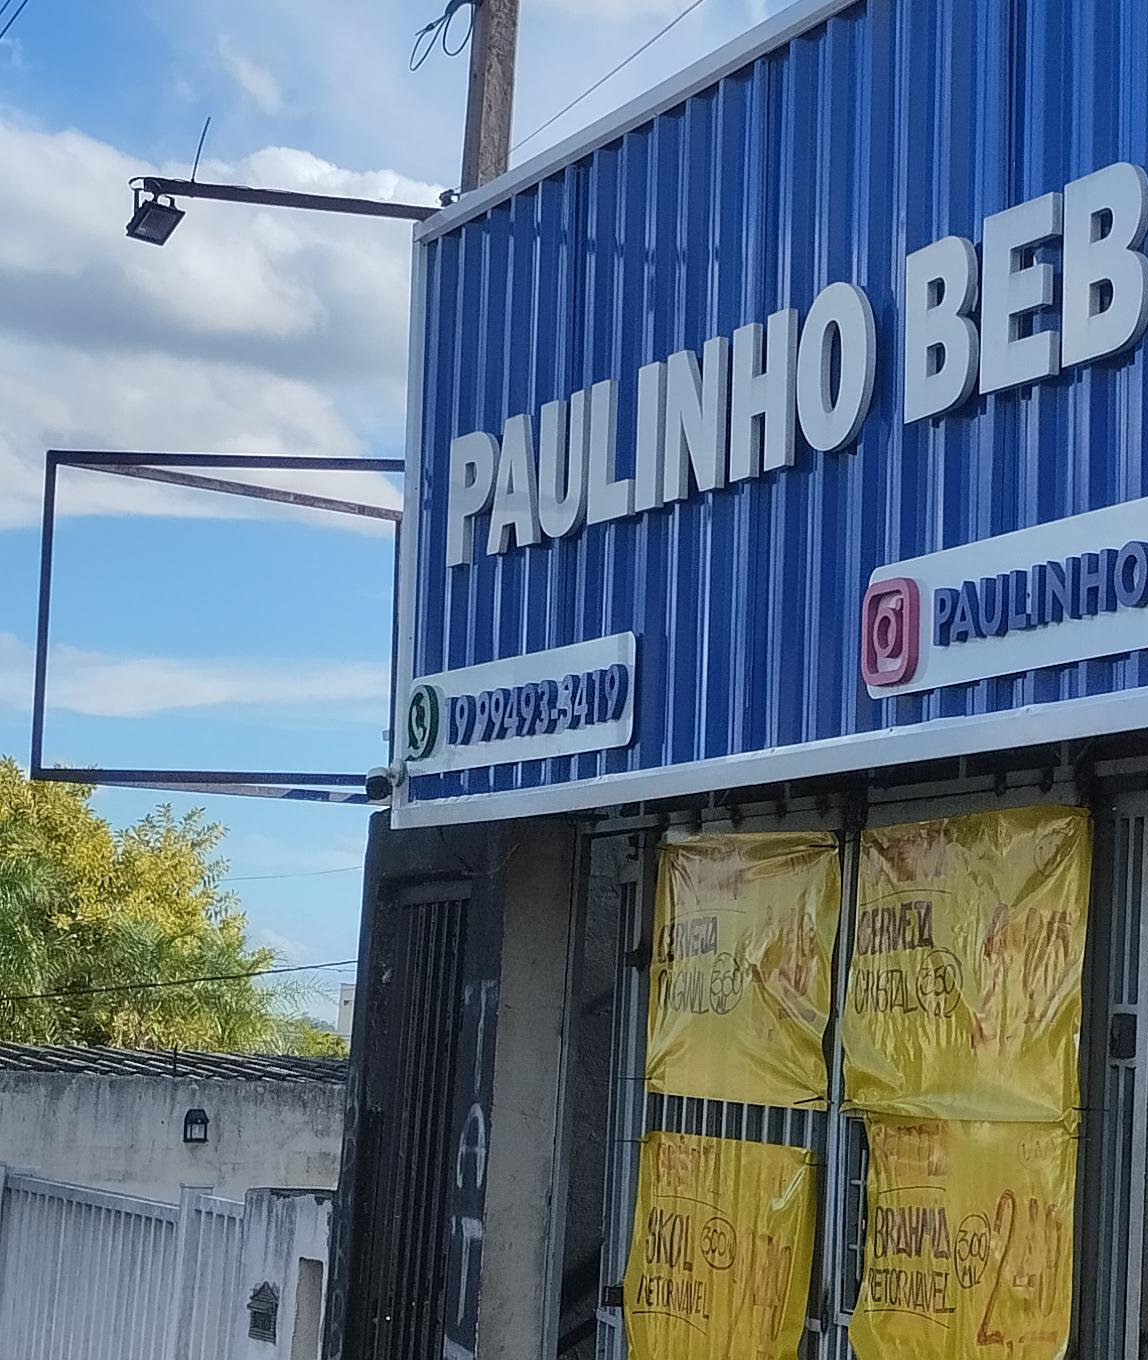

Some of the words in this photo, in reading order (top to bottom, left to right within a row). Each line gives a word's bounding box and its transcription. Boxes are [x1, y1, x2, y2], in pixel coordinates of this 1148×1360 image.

[446, 280, 877, 568] PAULINHO
[475, 663, 629, 743] 99493-3419
[857, 899, 934, 955] CERVEJA
[853, 969, 917, 1015] CRISTAL
[920, 964, 957, 997] 350
[645, 1205, 694, 1271] SKOL
[874, 1204, 952, 1260] BRAHMA
[957, 1228, 988, 1261] 300
[637, 1273, 710, 1320] RETORNAVEL
[865, 1268, 956, 1314] RETORNAVEL
